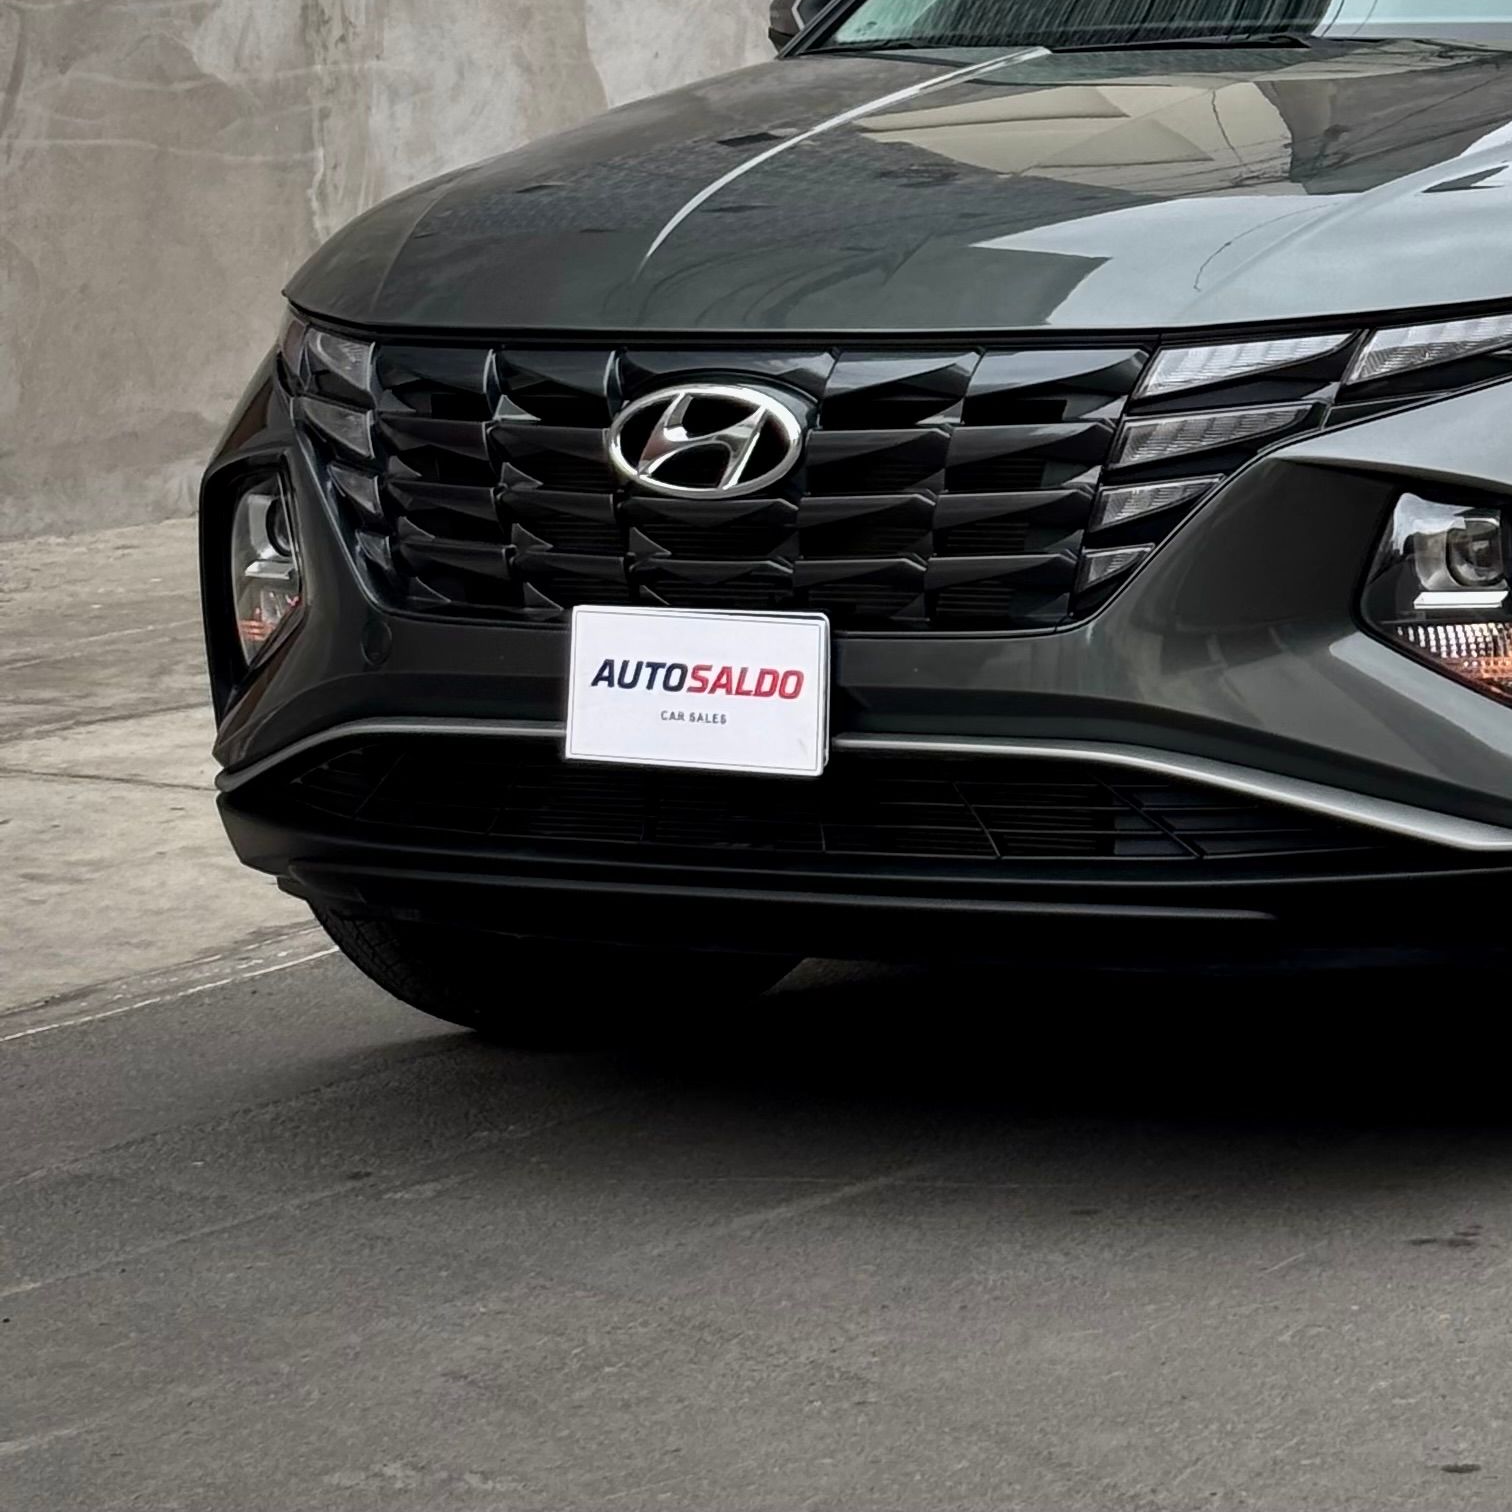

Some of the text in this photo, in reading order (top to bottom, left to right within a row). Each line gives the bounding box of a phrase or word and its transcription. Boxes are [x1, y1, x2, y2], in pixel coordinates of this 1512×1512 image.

[590, 658, 805, 700] AUTOSALDO
[660, 710, 728, 725] CAR SALES
